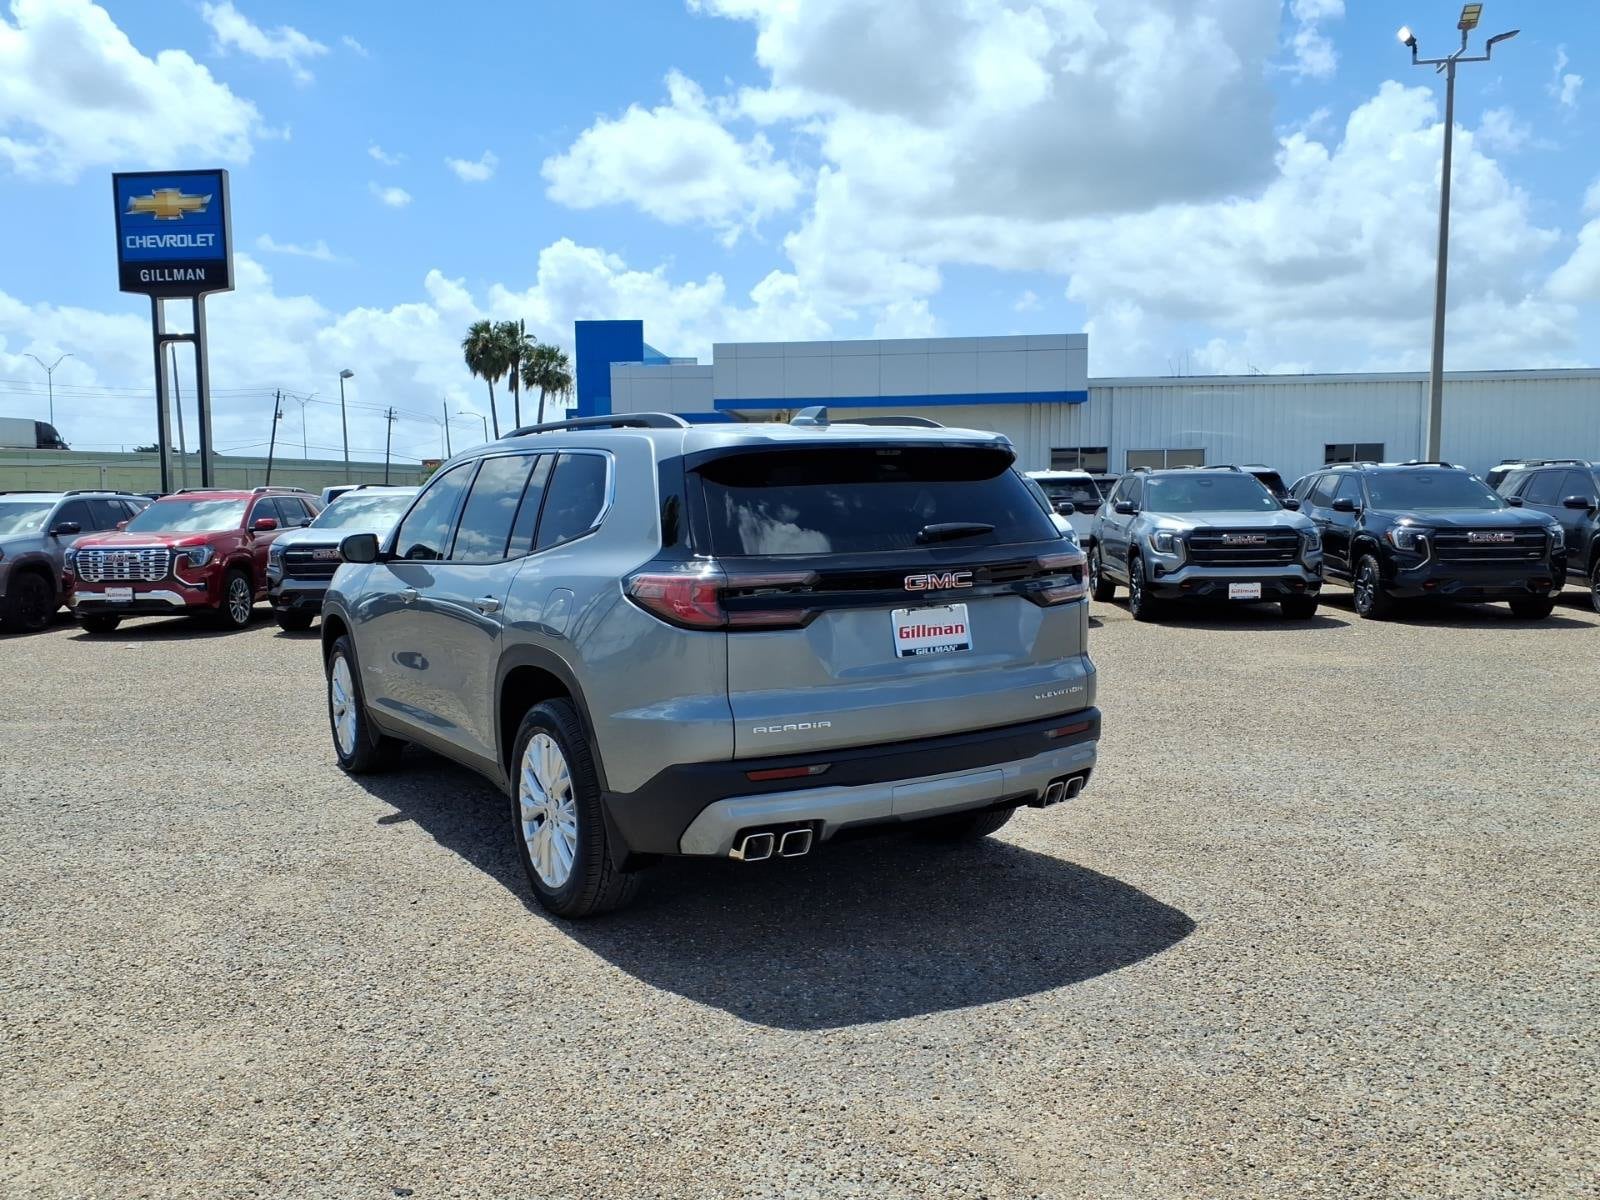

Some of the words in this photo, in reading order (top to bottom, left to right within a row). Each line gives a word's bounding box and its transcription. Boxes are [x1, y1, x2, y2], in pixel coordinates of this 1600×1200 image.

[126, 233, 215, 248] CHEVROLET
[140, 268, 205, 281] GILLMAN
[904, 571, 973, 591] GMC
[899, 624, 965, 639] Gillman
[753, 721, 832, 734] ACADIA
